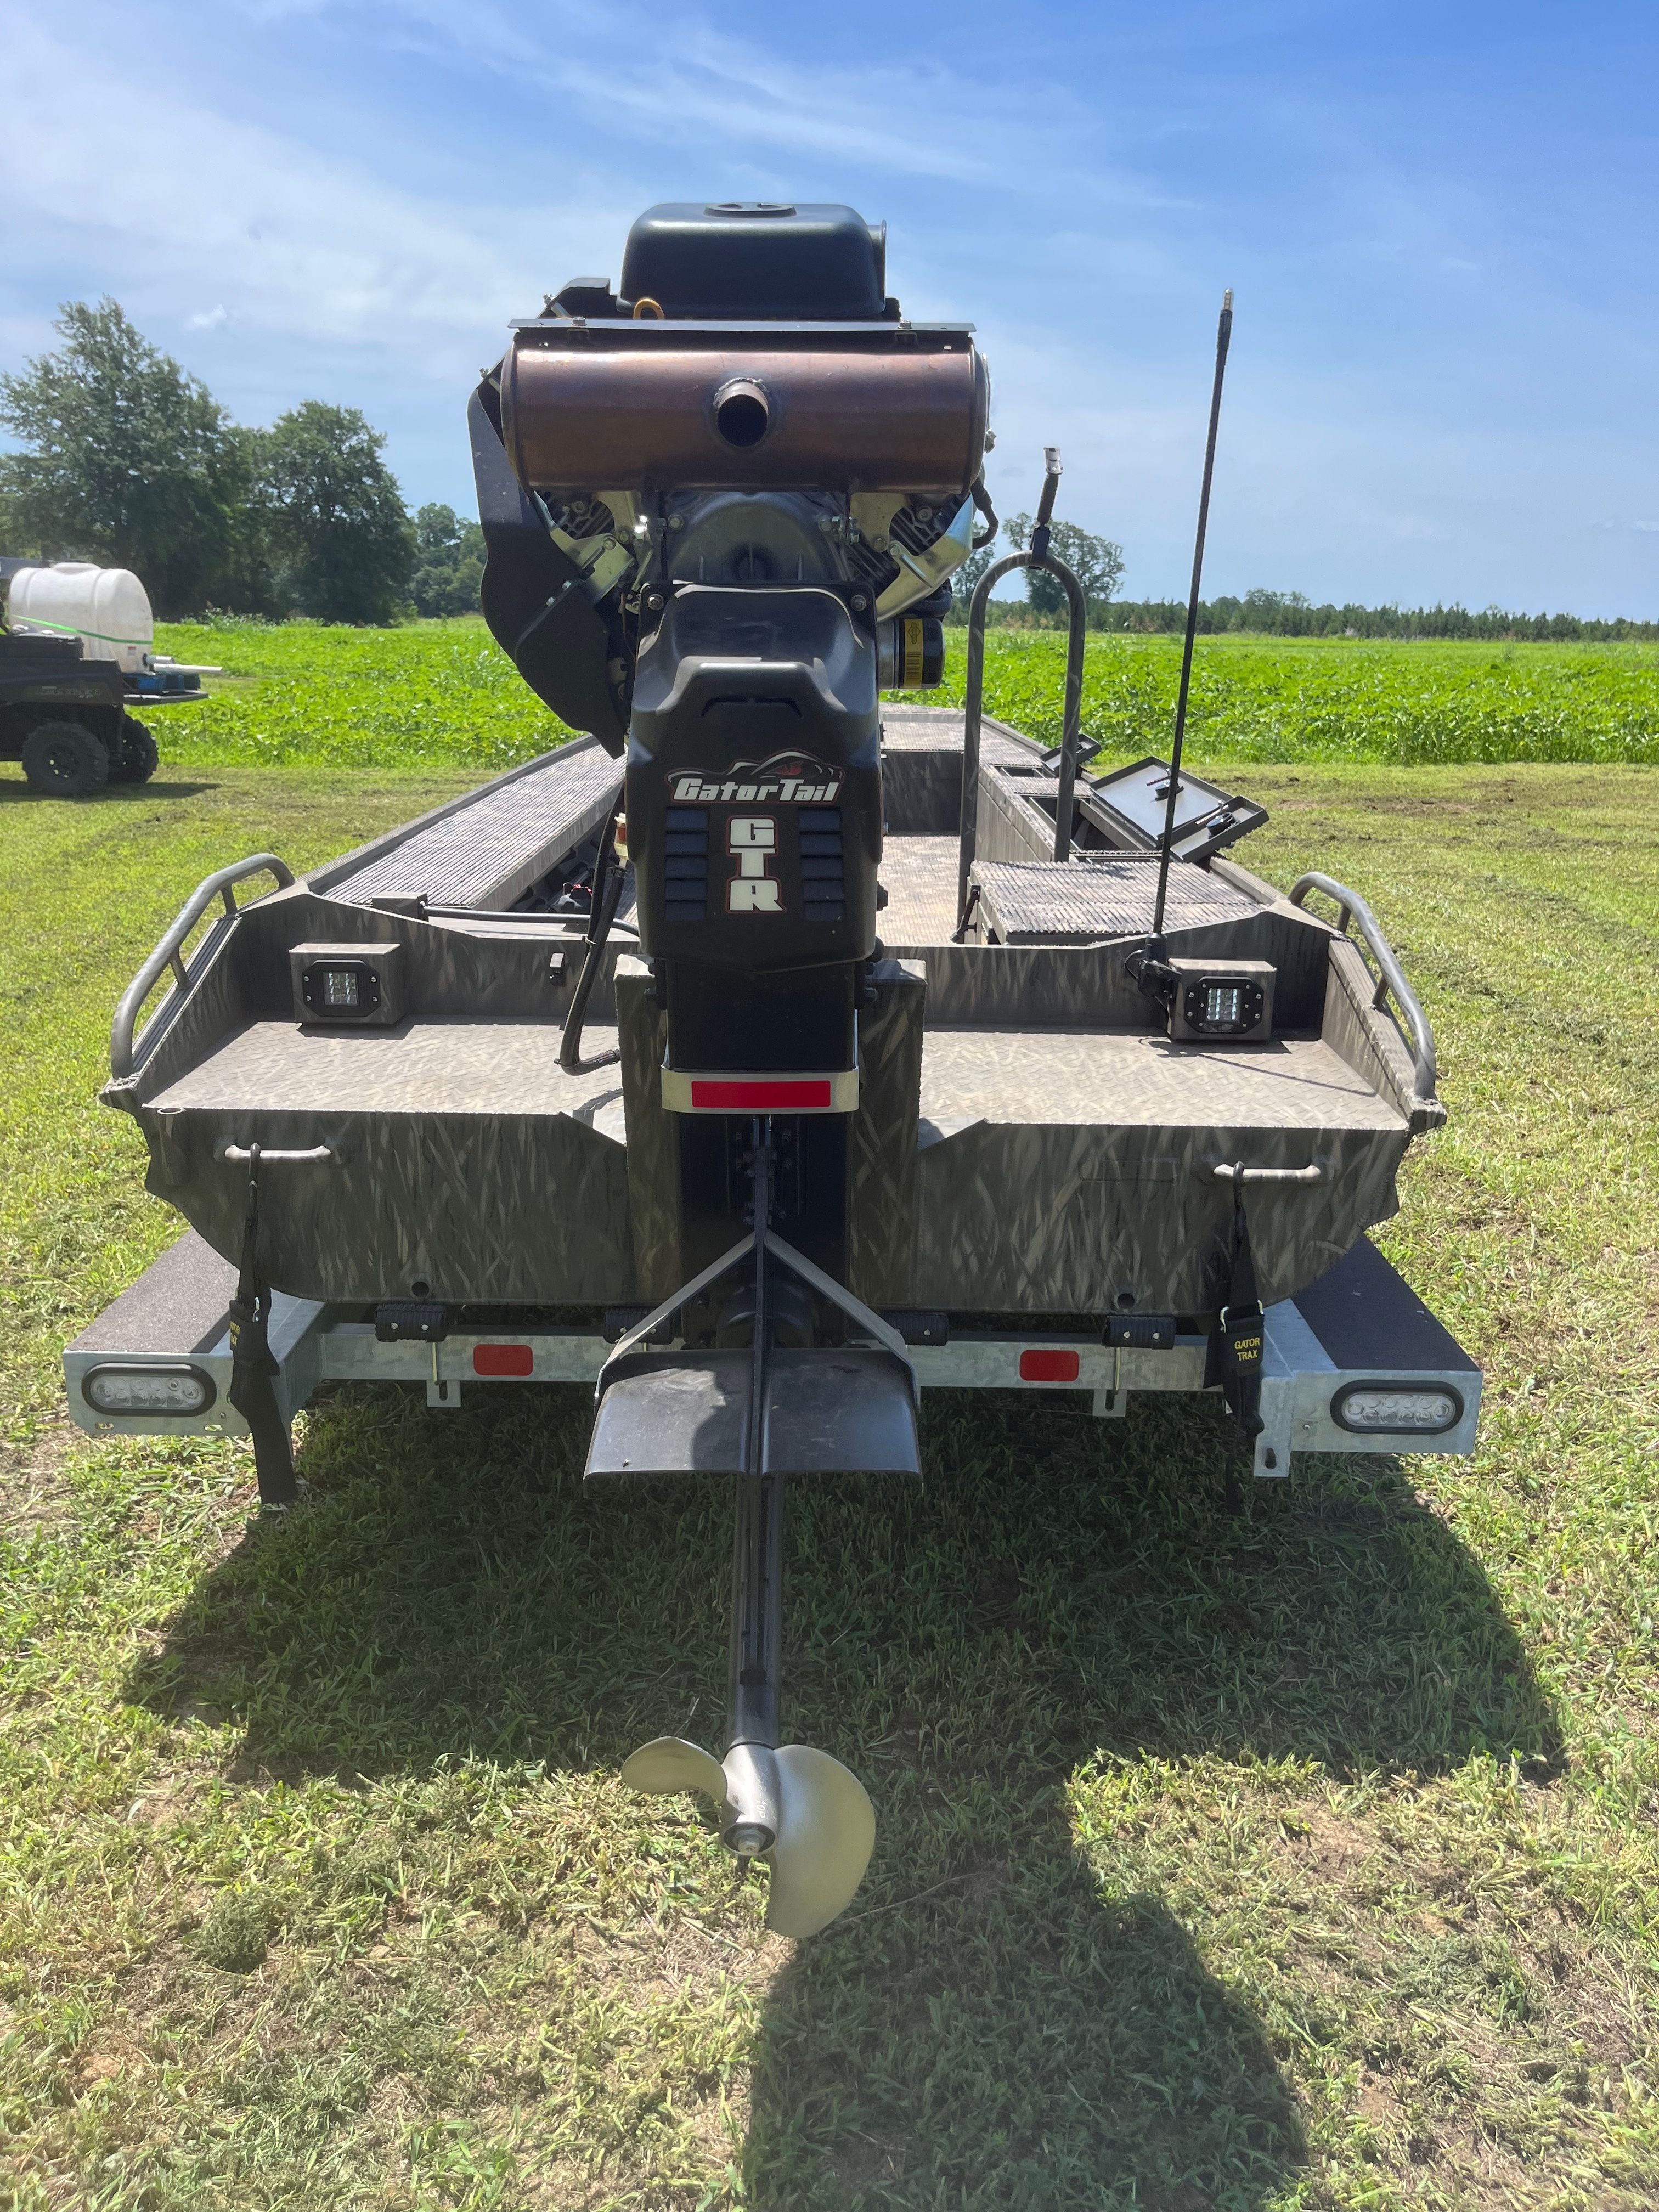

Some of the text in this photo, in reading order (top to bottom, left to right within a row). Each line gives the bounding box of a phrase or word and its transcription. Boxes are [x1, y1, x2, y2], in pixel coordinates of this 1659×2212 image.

[673, 778, 840, 802] GatorTail
[729, 818, 783, 911] GTR
[1234, 1337, 1260, 1350] GATOR
[1237, 1349, 1258, 1361] TRAX
